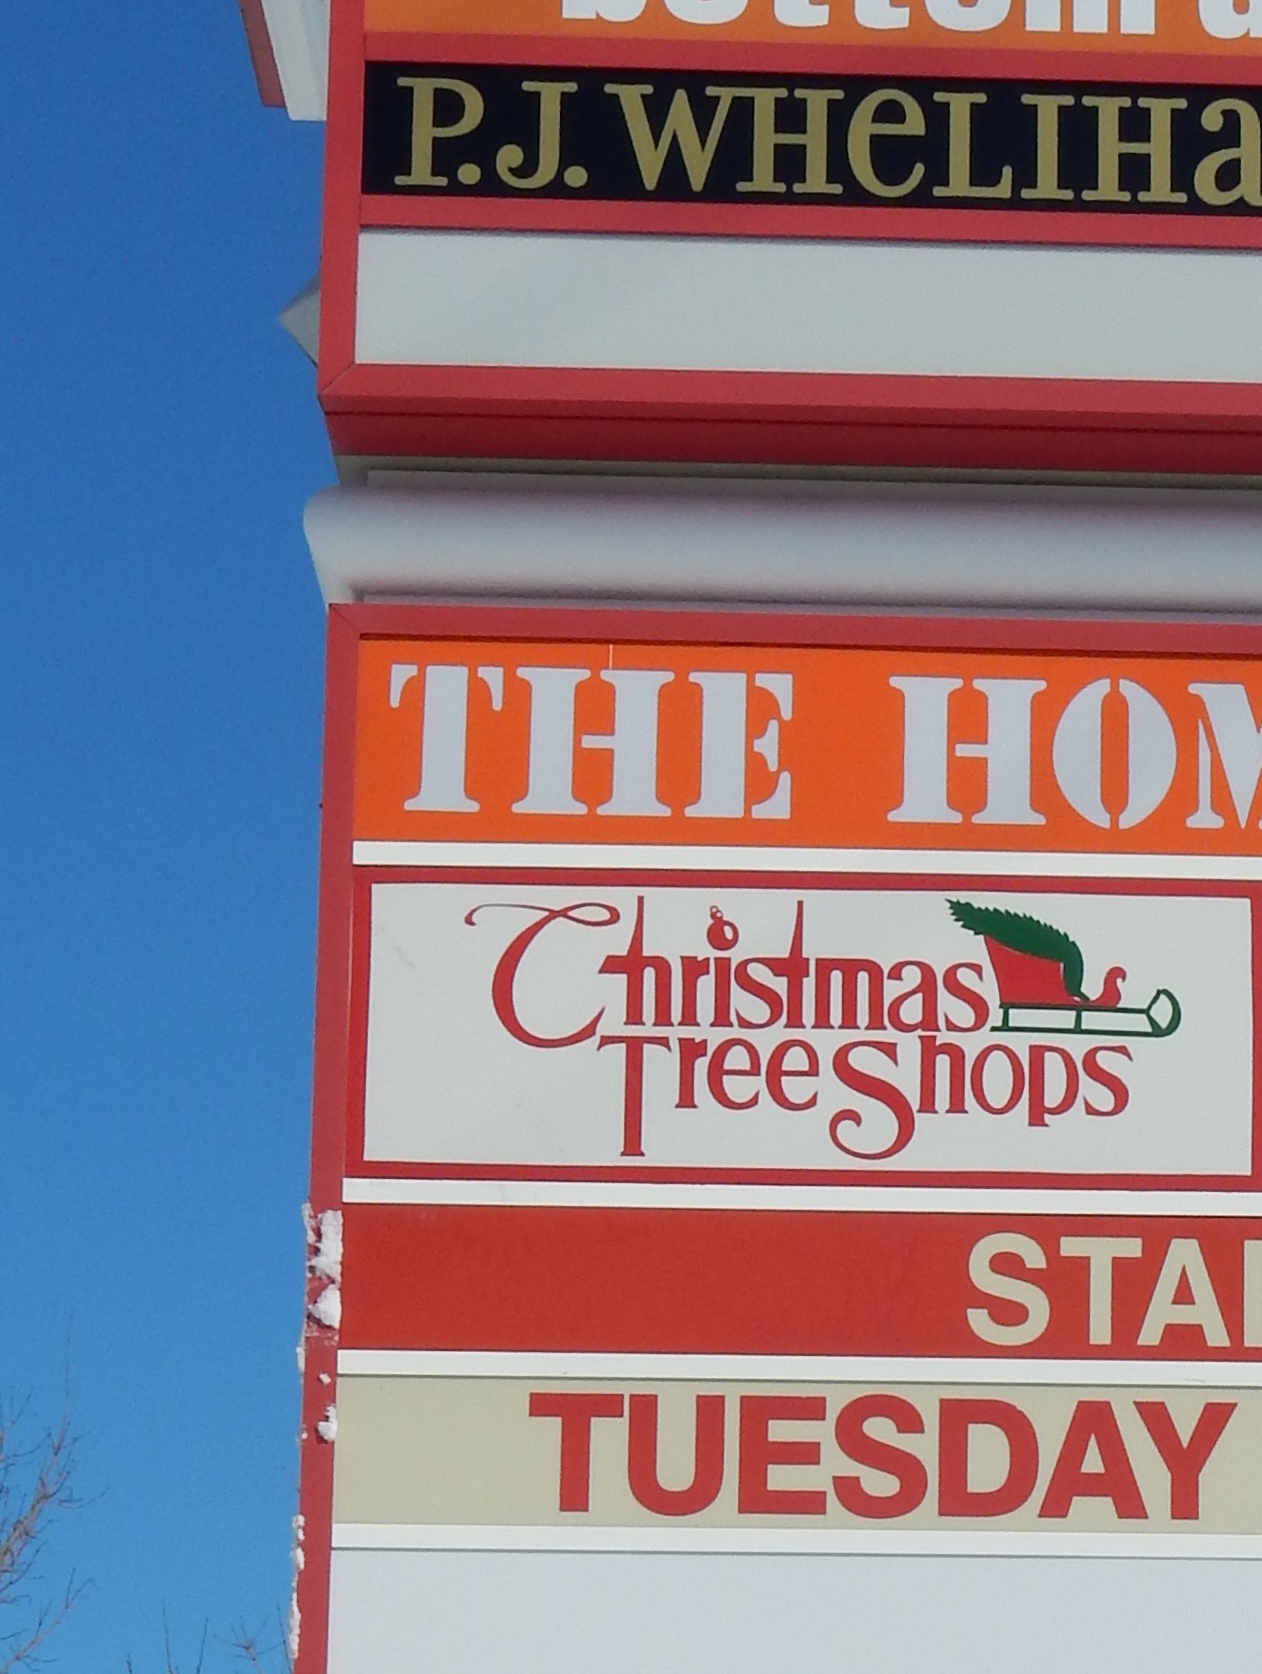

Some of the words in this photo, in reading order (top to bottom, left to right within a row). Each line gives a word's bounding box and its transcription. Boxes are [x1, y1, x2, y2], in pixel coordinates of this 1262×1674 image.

[394, 76, 588, 190] P.J.
[388, 664, 795, 821] THE
[464, 895, 991, 1051] Christmas
[597, 1035, 820, 1158] Tree
[829, 1034, 1134, 1160] Shops
[529, 1391, 1238, 1521] TUESDAY
